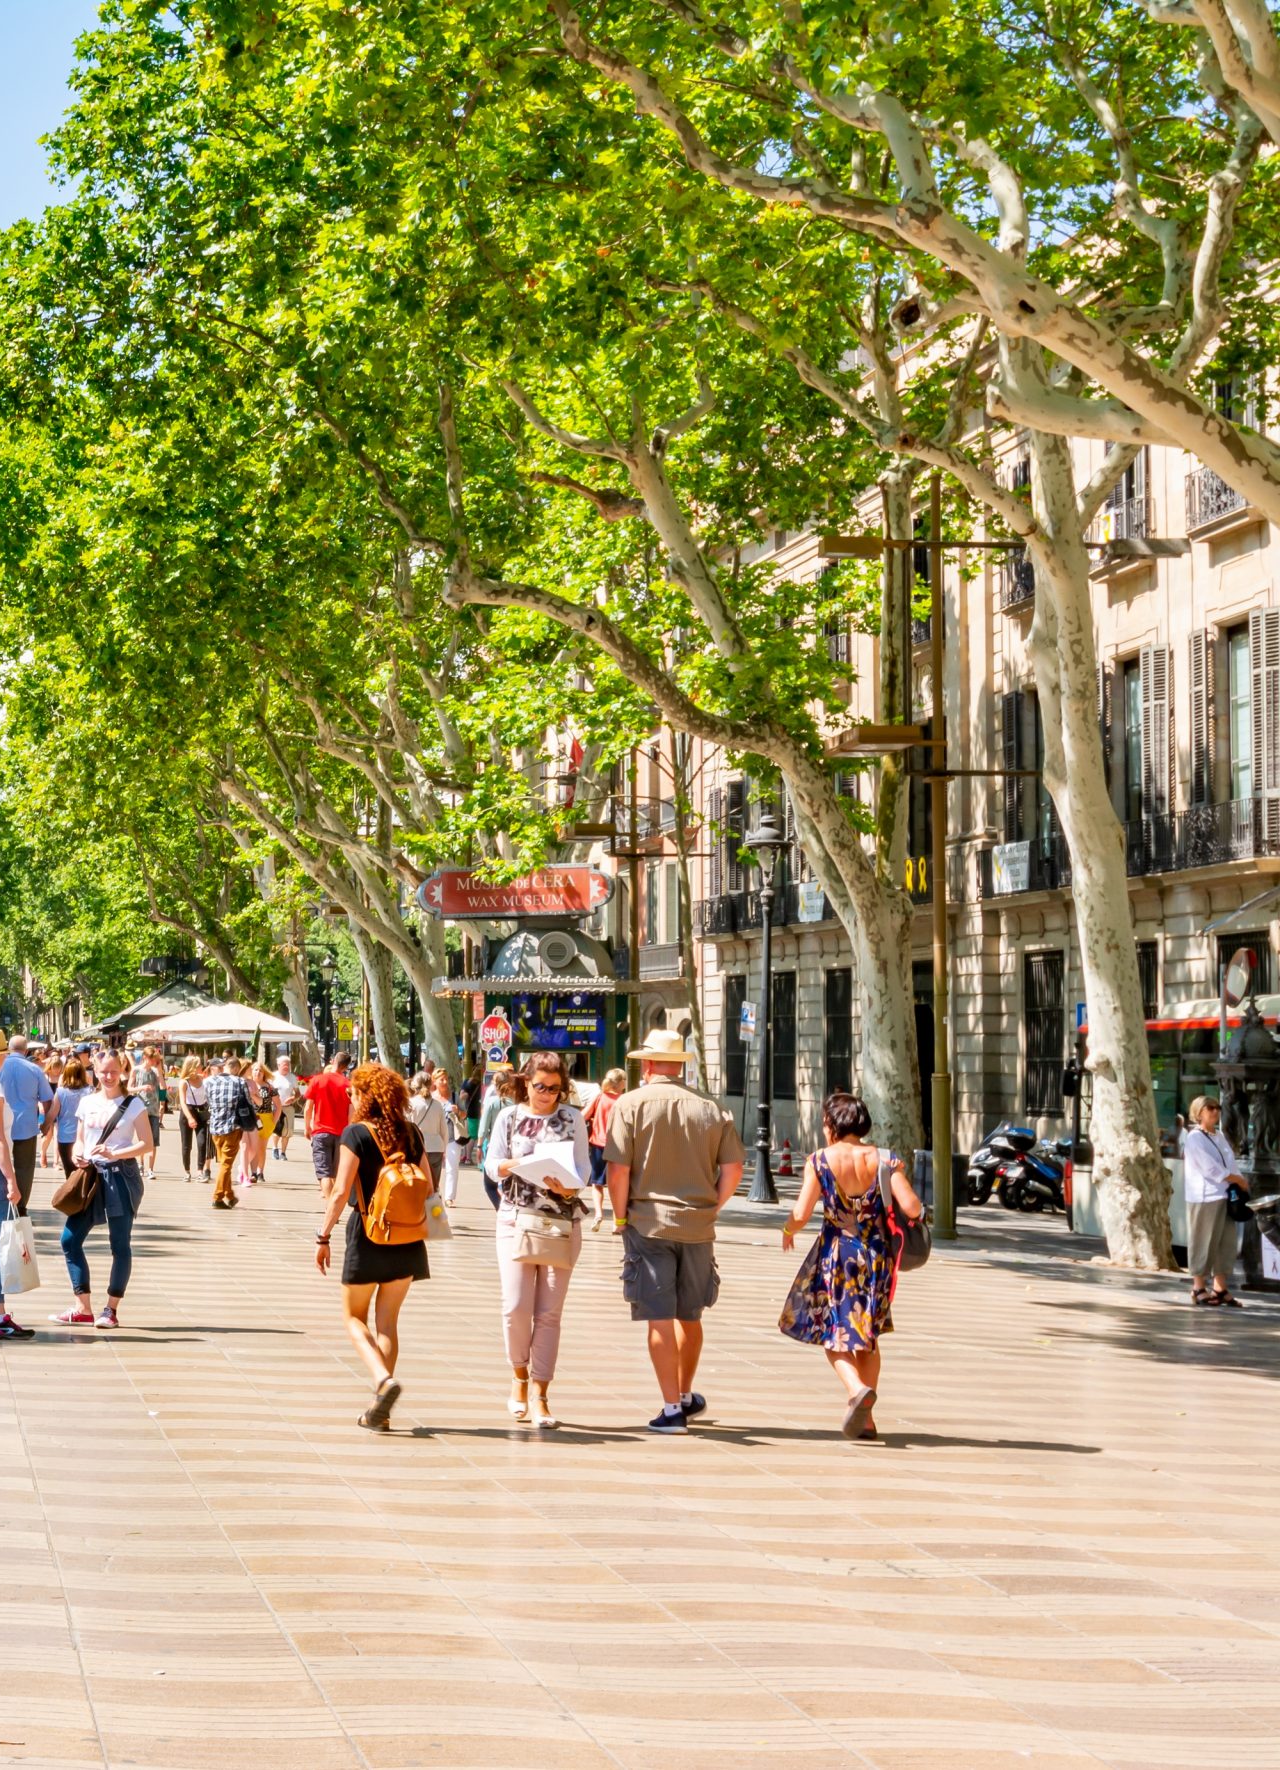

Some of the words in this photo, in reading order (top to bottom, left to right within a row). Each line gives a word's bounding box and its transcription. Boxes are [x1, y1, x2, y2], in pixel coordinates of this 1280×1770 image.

[532, 874, 577, 889] CERA
[467, 896, 499, 908] WAX
[502, 894, 564, 907] MUSEUM
[484, 1028, 508, 1039] SHOP
